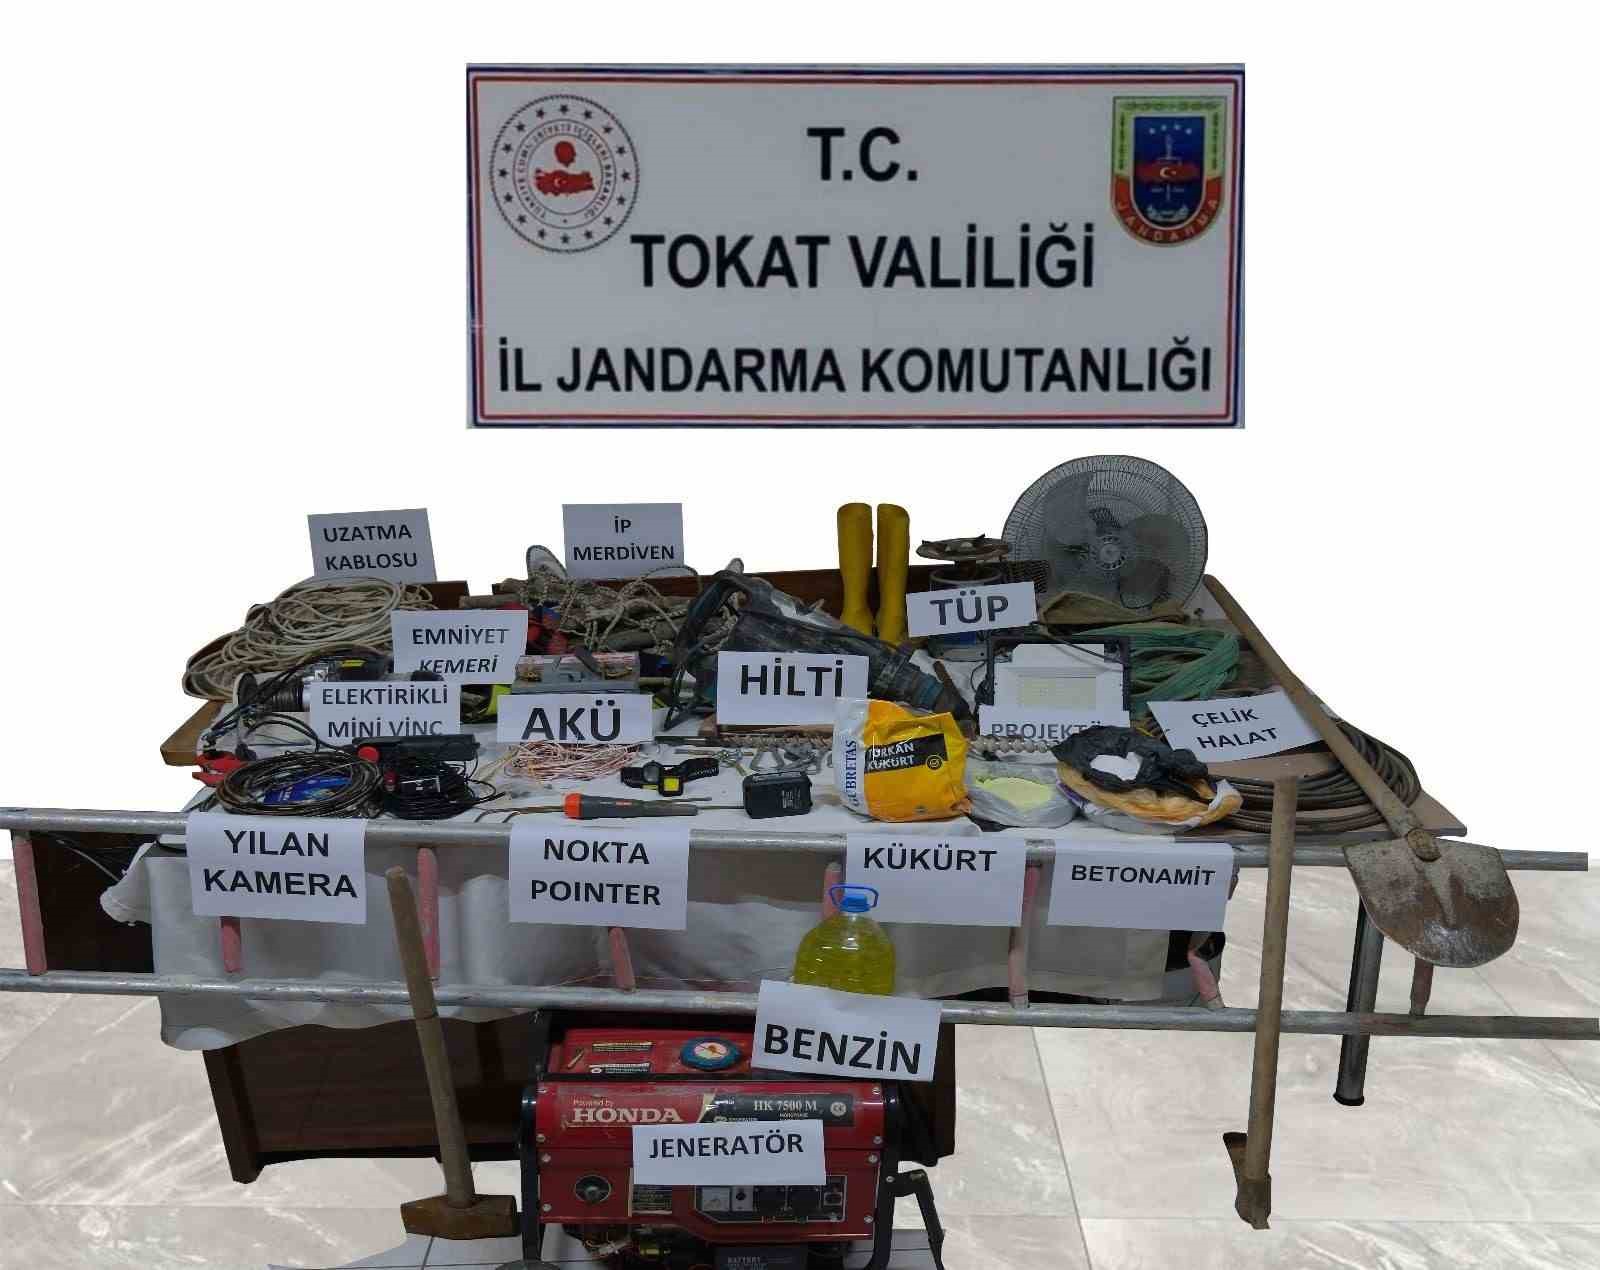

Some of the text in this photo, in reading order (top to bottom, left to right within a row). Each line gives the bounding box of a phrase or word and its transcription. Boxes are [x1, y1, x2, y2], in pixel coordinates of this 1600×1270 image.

[807, 126, 918, 182] T.C.
[630, 222, 1095, 289] TOKAT VALİLİĞİ
[499, 335, 1212, 394] İL JANDARMA KOMUTANLIĞI
[323, 524, 413, 543] UZATMA
[614, 515, 632, 534] İP
[325, 552, 418, 571] KABLOSU
[573, 542, 675, 561] MERDİVEN
[929, 590, 1010, 626] TÜP
[411, 624, 511, 645] EMNİYET
[417, 654, 499, 674] KEMERİ
[740, 656, 845, 698] HİLTİ
[322, 684, 449, 705] ELEKTİRİKLİ
[328, 717, 383, 738] MİNİ
[521, 699, 622, 742] AKÜ
[1191, 707, 1260, 728] ÇELİK
[1196, 726, 1278, 749] HALAT
[223, 829, 329, 857] YILAN
[543, 838, 650, 865] NOKTA
[863, 842, 998, 872] KÜKÜRT
[203, 868, 358, 898] KAMERA
[1071, 864, 1216, 886] BETONAMİT
[531, 879, 661, 906] POINTER
[763, 1023, 922, 1076] BENZİN
[572, 1108, 684, 1123] HONDA
[754, 1100, 773, 1111] HK
[805, 1100, 818, 1112] M
[649, 1129, 804, 1159] JENERATÖR
